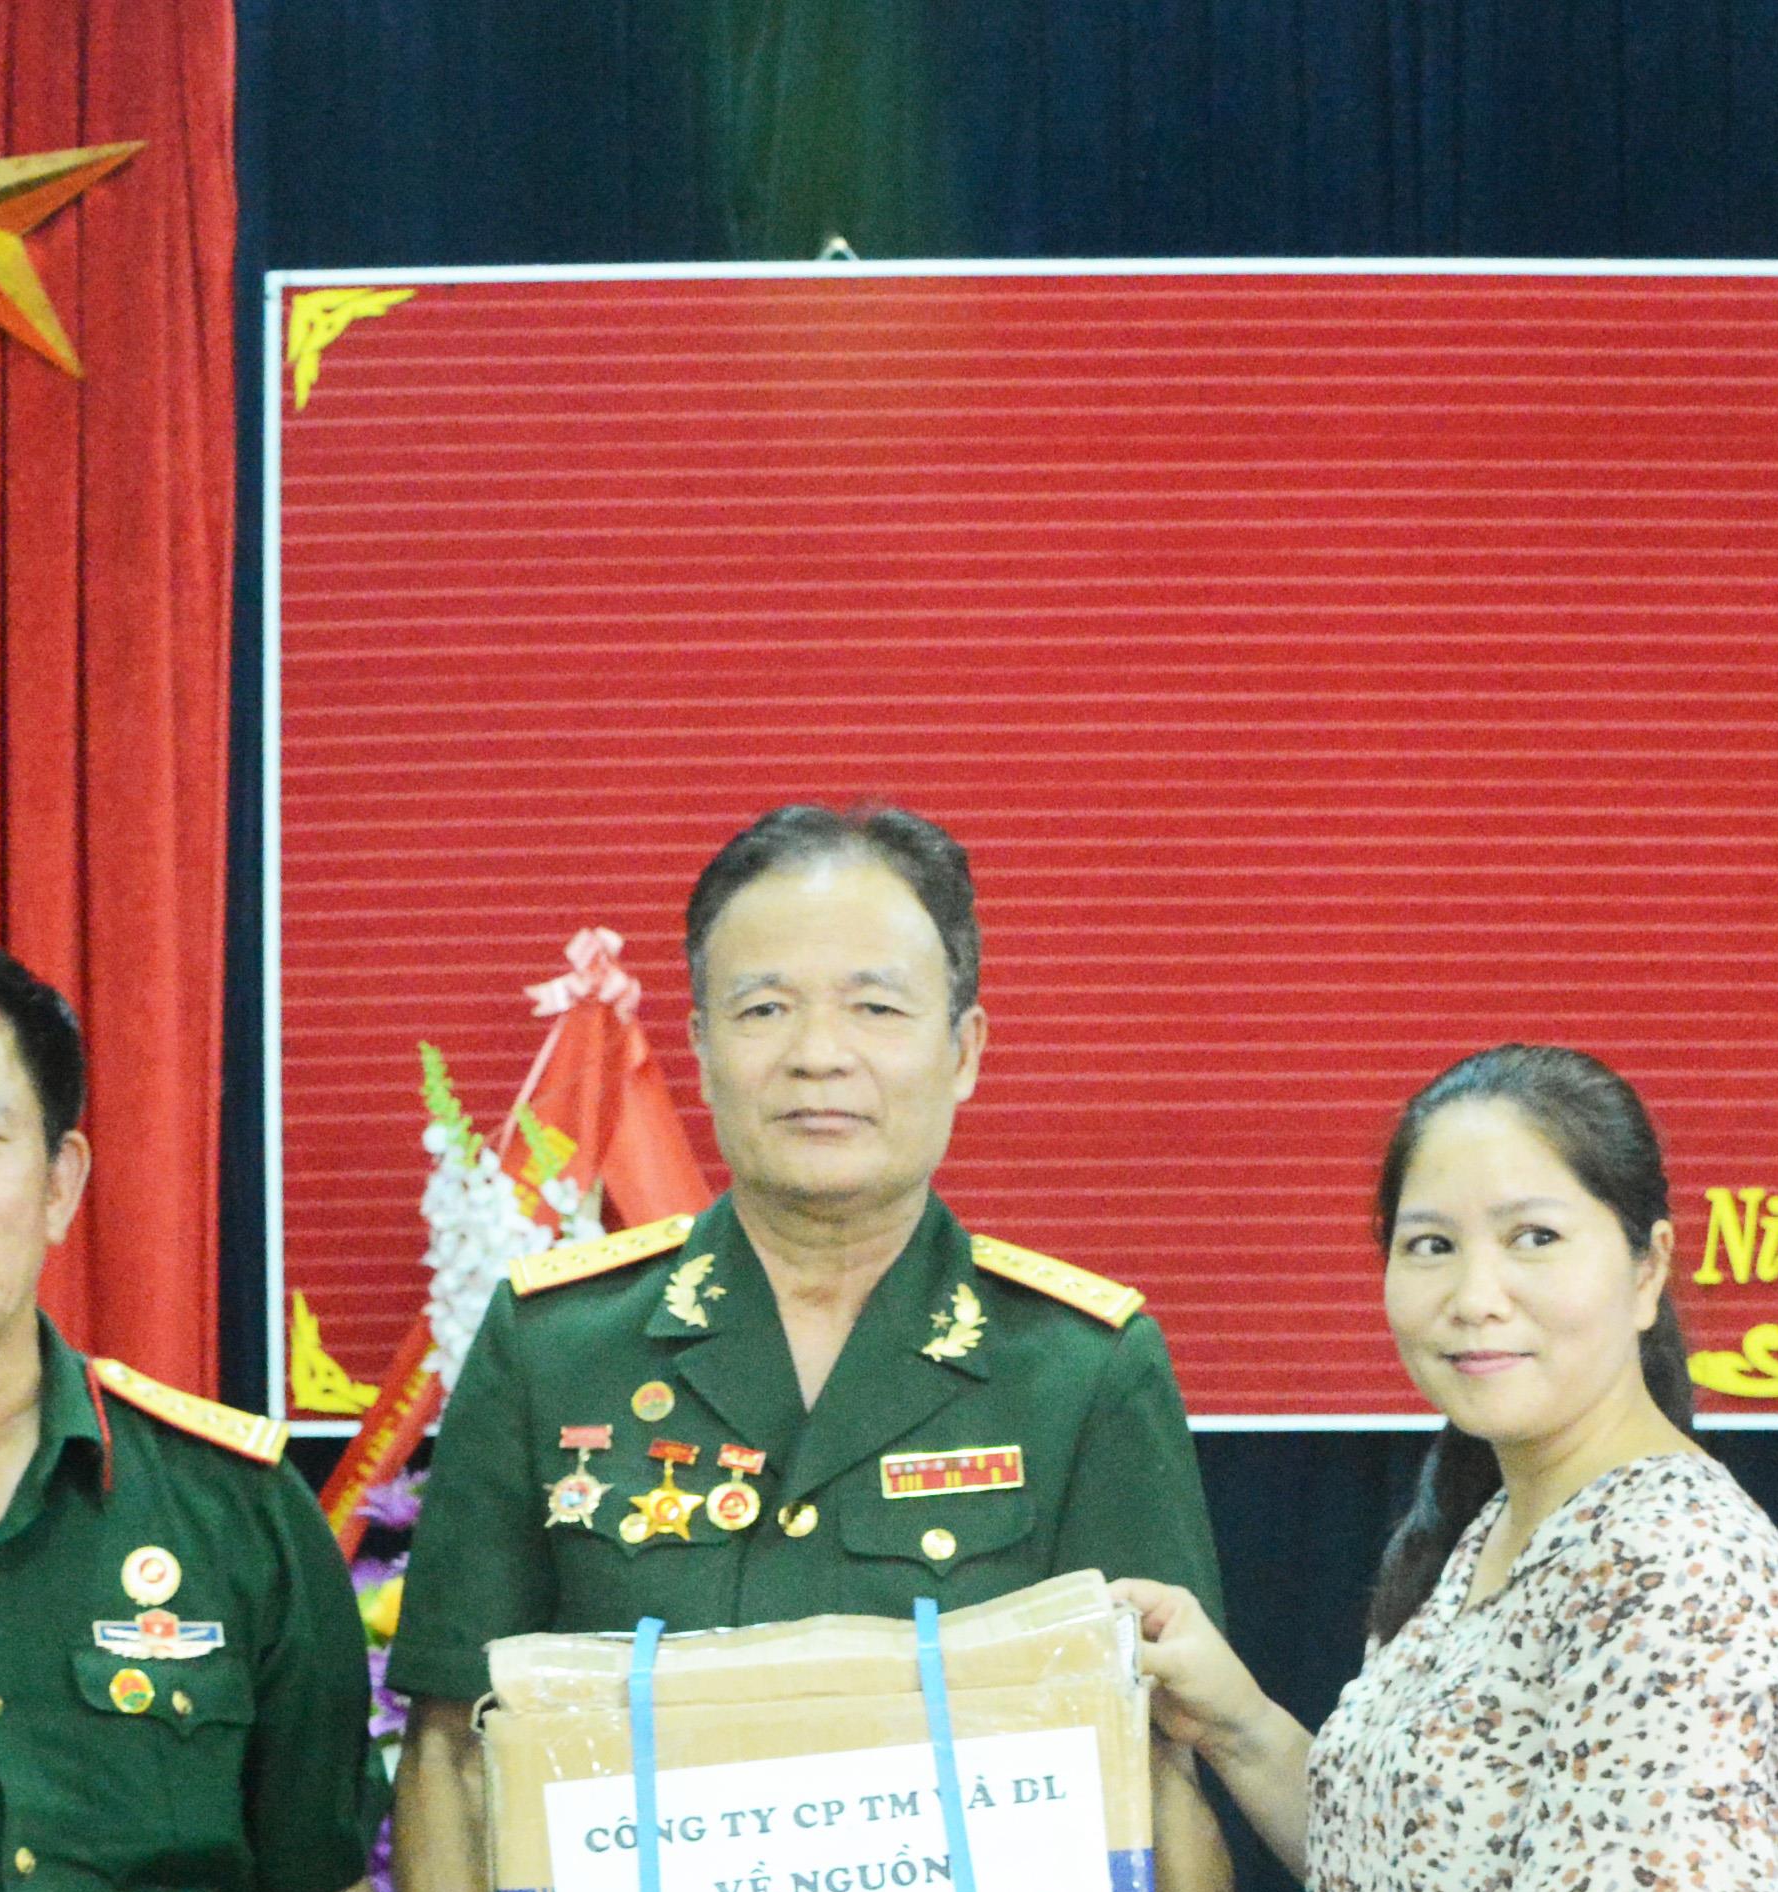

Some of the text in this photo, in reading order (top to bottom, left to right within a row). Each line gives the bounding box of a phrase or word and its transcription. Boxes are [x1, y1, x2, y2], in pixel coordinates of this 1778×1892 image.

[585, 1774, 1067, 1853] CÔNG TY CP TM À DL
